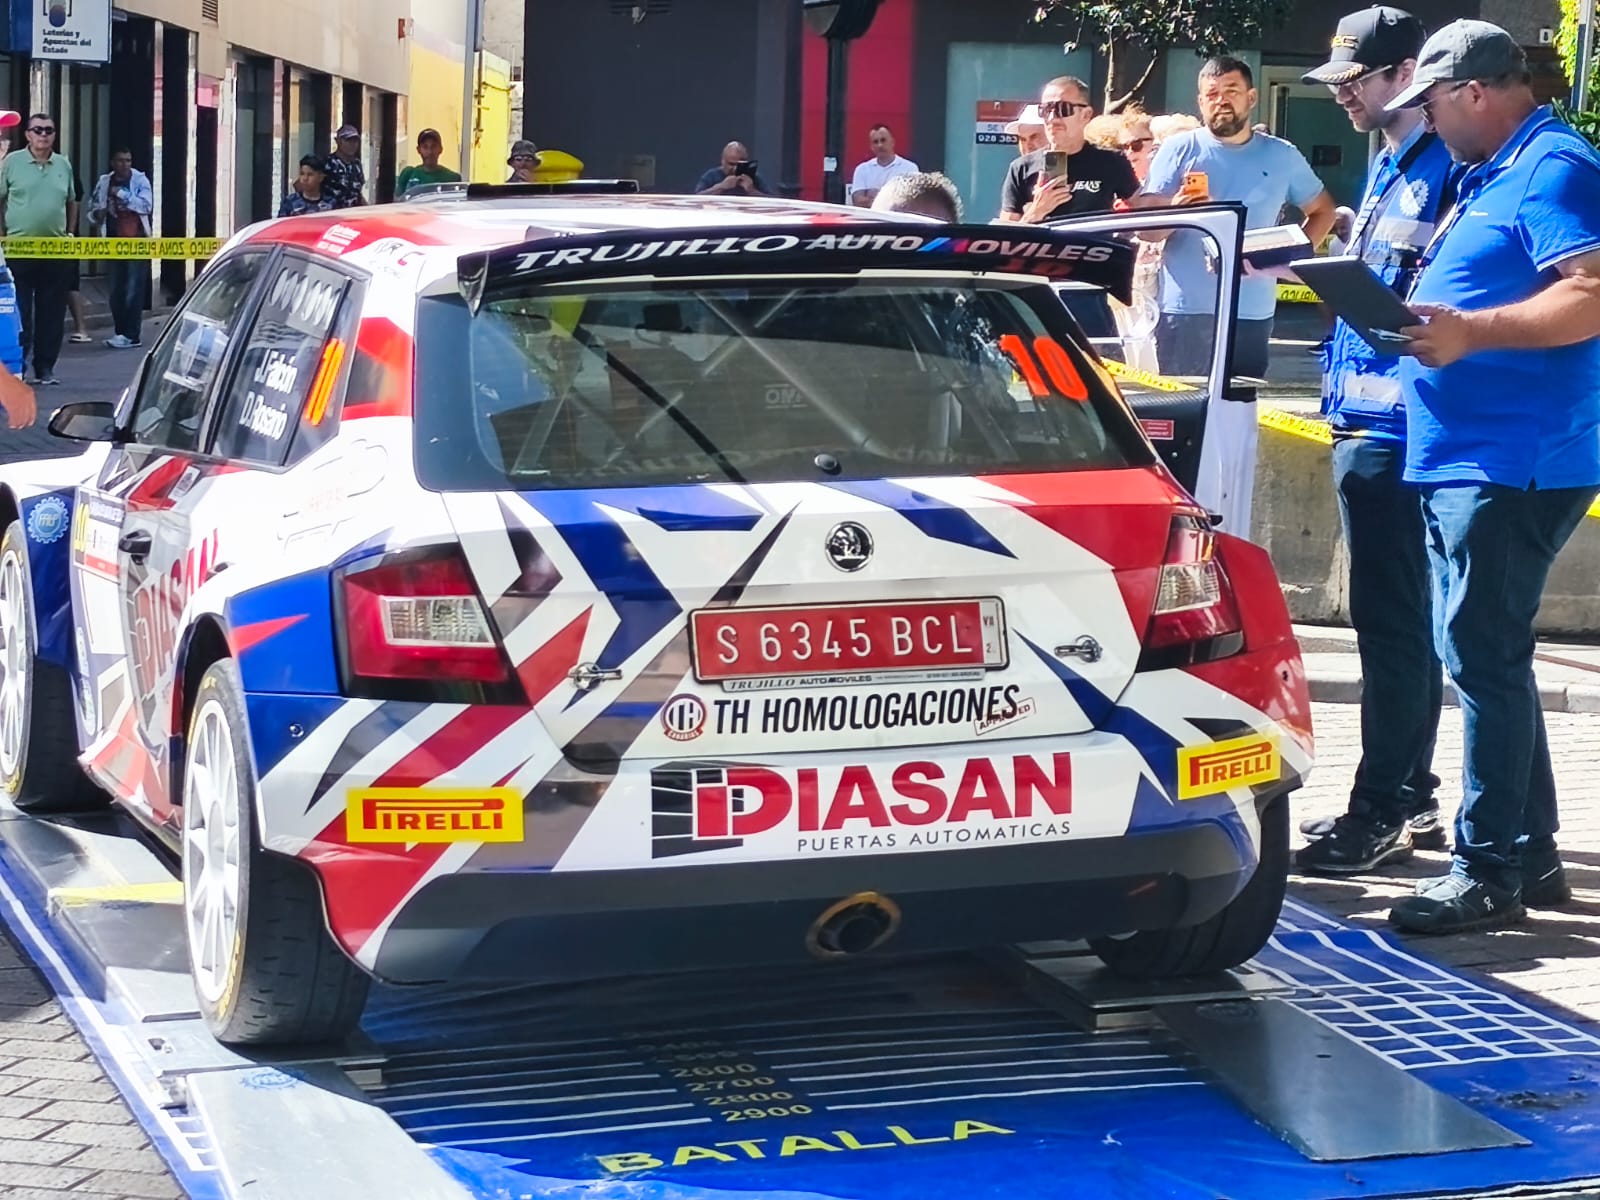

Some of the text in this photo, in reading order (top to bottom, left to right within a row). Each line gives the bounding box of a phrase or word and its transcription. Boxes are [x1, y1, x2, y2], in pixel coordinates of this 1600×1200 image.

[515, 234, 800, 270] TRUJILLO
[305, 337, 345, 426] 10
[1000, 334, 1089, 402] 10
[716, 615, 973, 664] S 6345 BCL
[730, 679, 796, 689] TRUJILLO
[713, 684, 1020, 735] TH HOMOLOGACIONES
[1189, 741, 1273, 787] PIRELLI
[697, 752, 1072, 837] DIASAN
[362, 798, 505, 830] PIRELLI
[797, 821, 1072, 852] PUERTAS AUTOMATICAS
[669, 1063, 757, 1078] 2600
[685, 1076, 776, 1092] 2700
[703, 1091, 793, 1106] 2800
[720, 1104, 813, 1122] 2900
[596, 1119, 1017, 1174] BATALLA
